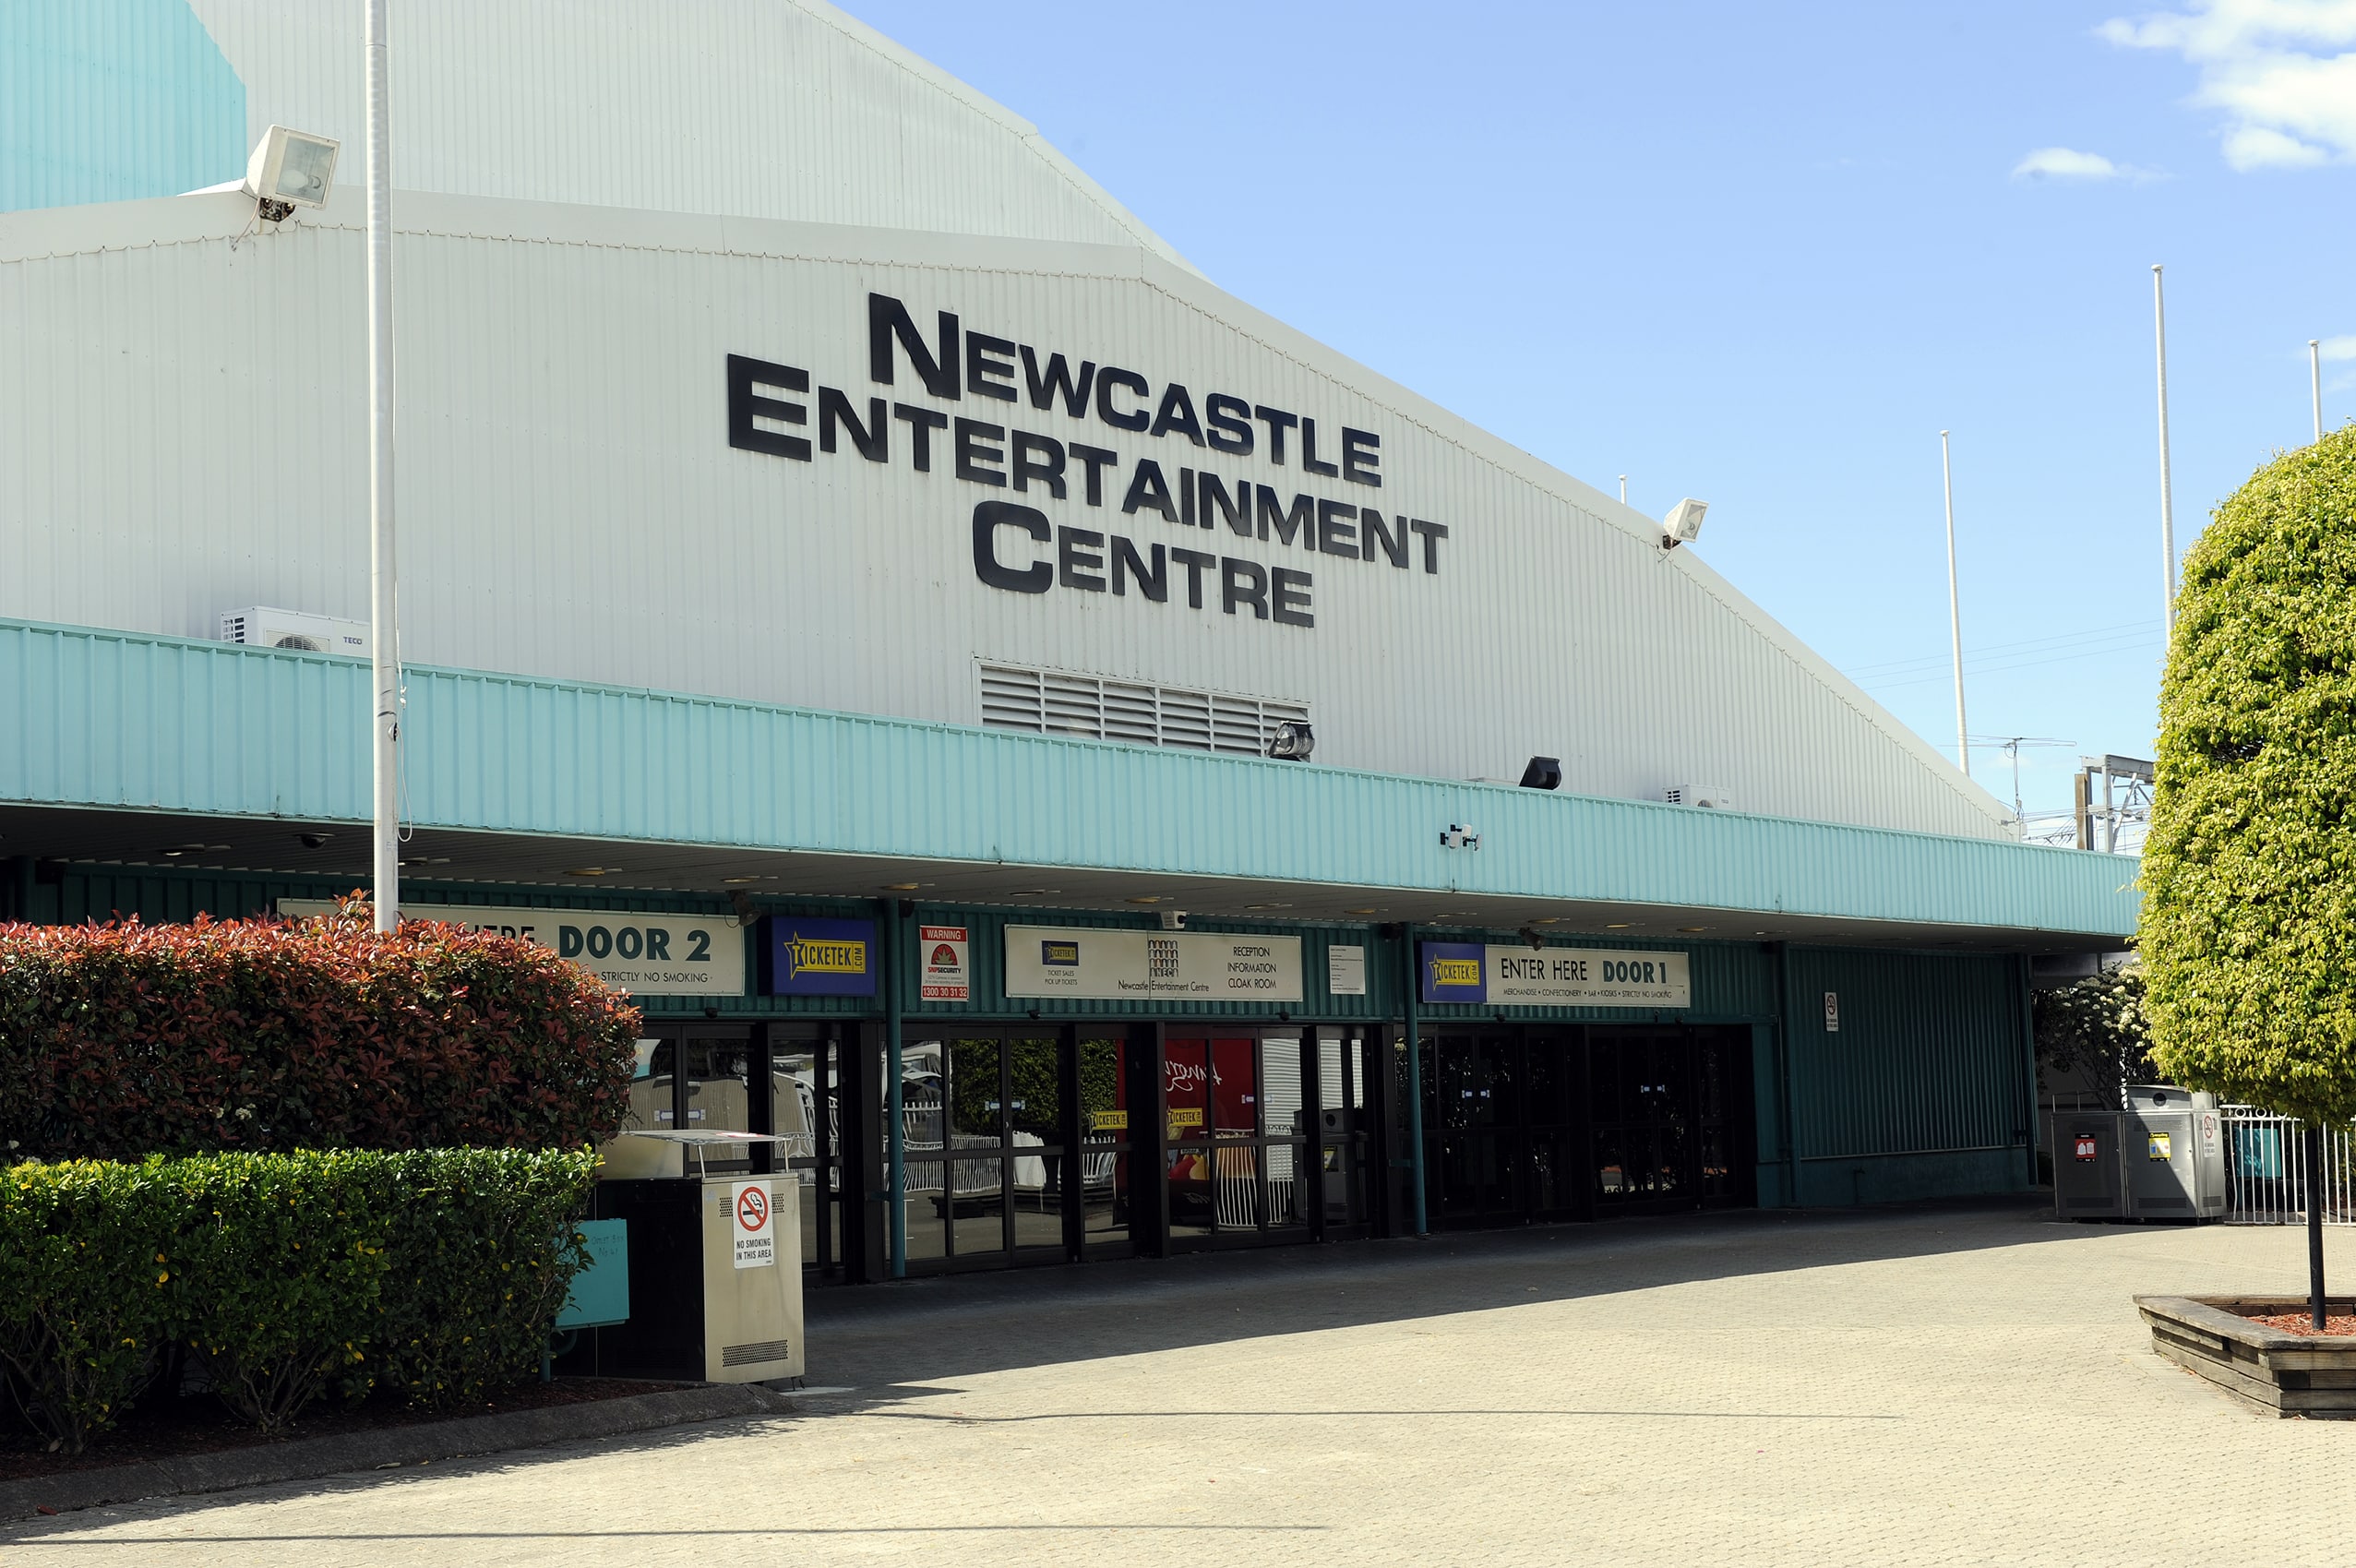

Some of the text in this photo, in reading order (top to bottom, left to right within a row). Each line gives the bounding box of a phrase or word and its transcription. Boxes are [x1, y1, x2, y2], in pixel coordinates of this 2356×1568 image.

[869, 292, 1381, 487] NEWCASTLE
[727, 353, 1449, 575] ENTERTAINMENT
[973, 500, 1314, 628] CENTRE
[343, 636, 363, 645] TECO
[927, 929, 962, 940] WARNING
[559, 925, 672, 961] DOOR
[685, 929, 711, 962] 2
[792, 945, 852, 966] TICKETEK
[1233, 946, 1270, 957] RECEPTION
[1227, 963, 1276, 973] INFORMATION
[1433, 964, 1470, 980] TICKETEK
[1501, 958, 1667, 984] ENTER HERE DOOR 1
[601, 971, 708, 983] STRICTLY NO SMOKING
[1228, 978, 1276, 988] CLOAK ROOM
[923, 987, 967, 997] 1300 30 31 32
[1118, 980, 1210, 992] Newcastle Entertainment Centre
[1090, 1113, 1120, 1126] TICKETEK
[1167, 1111, 1196, 1125] TICKETEK
[736, 1238, 771, 1249] NO SMOKING
[736, 1249, 771, 1261] IN THIS AREA
